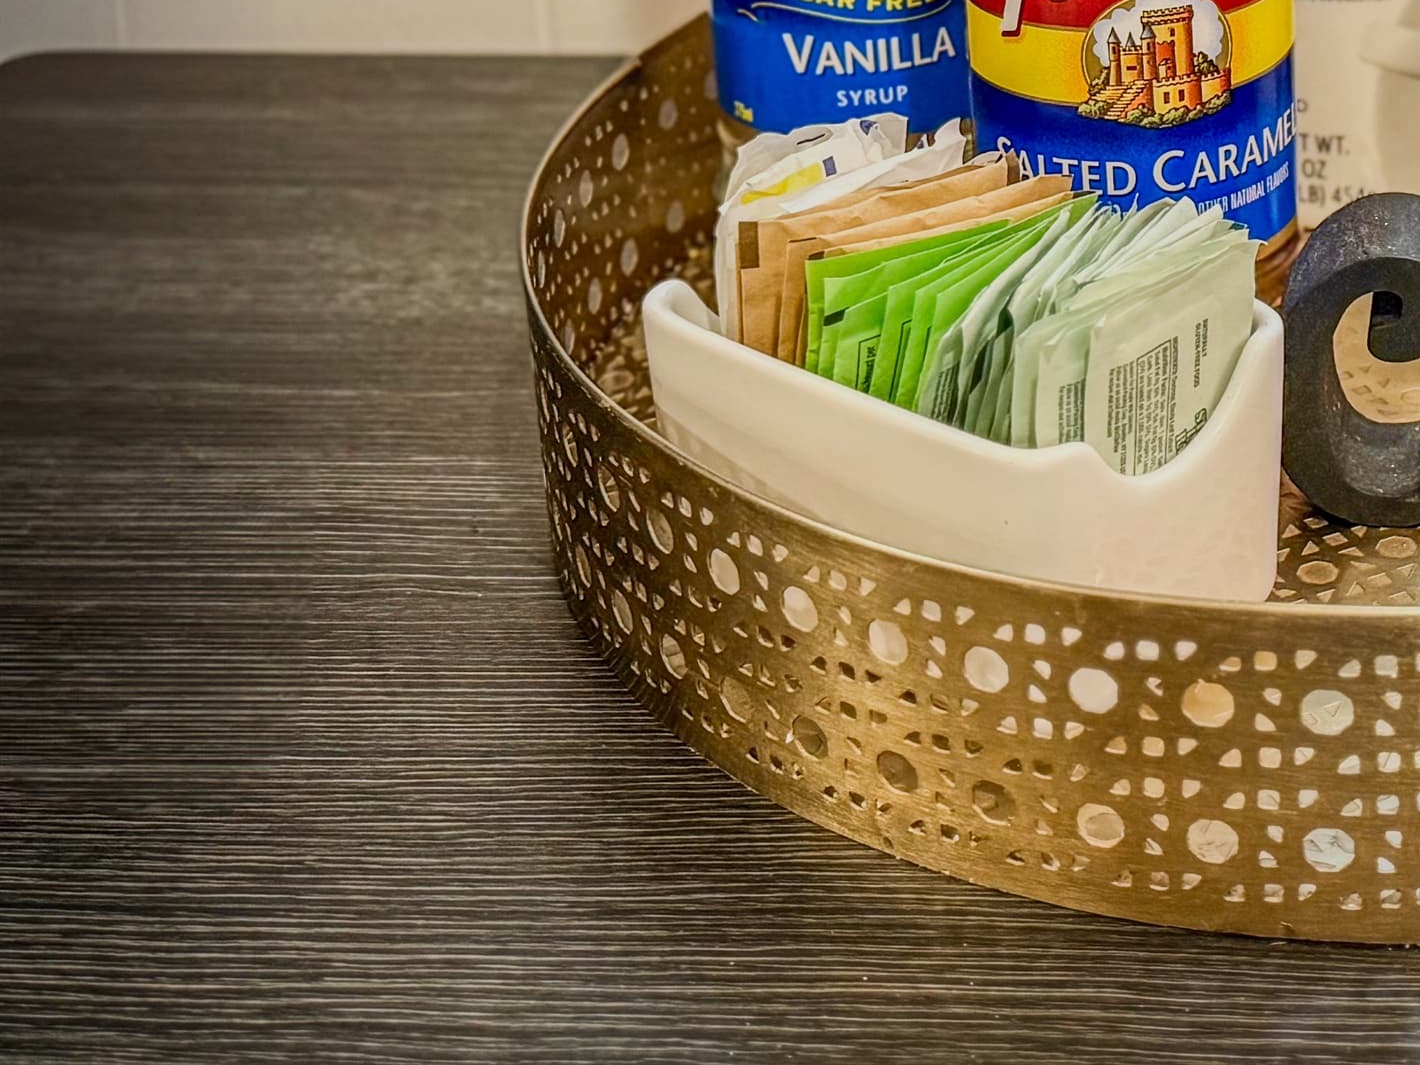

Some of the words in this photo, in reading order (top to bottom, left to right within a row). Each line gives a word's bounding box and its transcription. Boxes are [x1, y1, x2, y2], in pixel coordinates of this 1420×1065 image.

[781, 26, 957, 76] VANILLA
[836, 84, 909, 108] SYRUP
[1230, 179, 1266, 211] NATURAL
